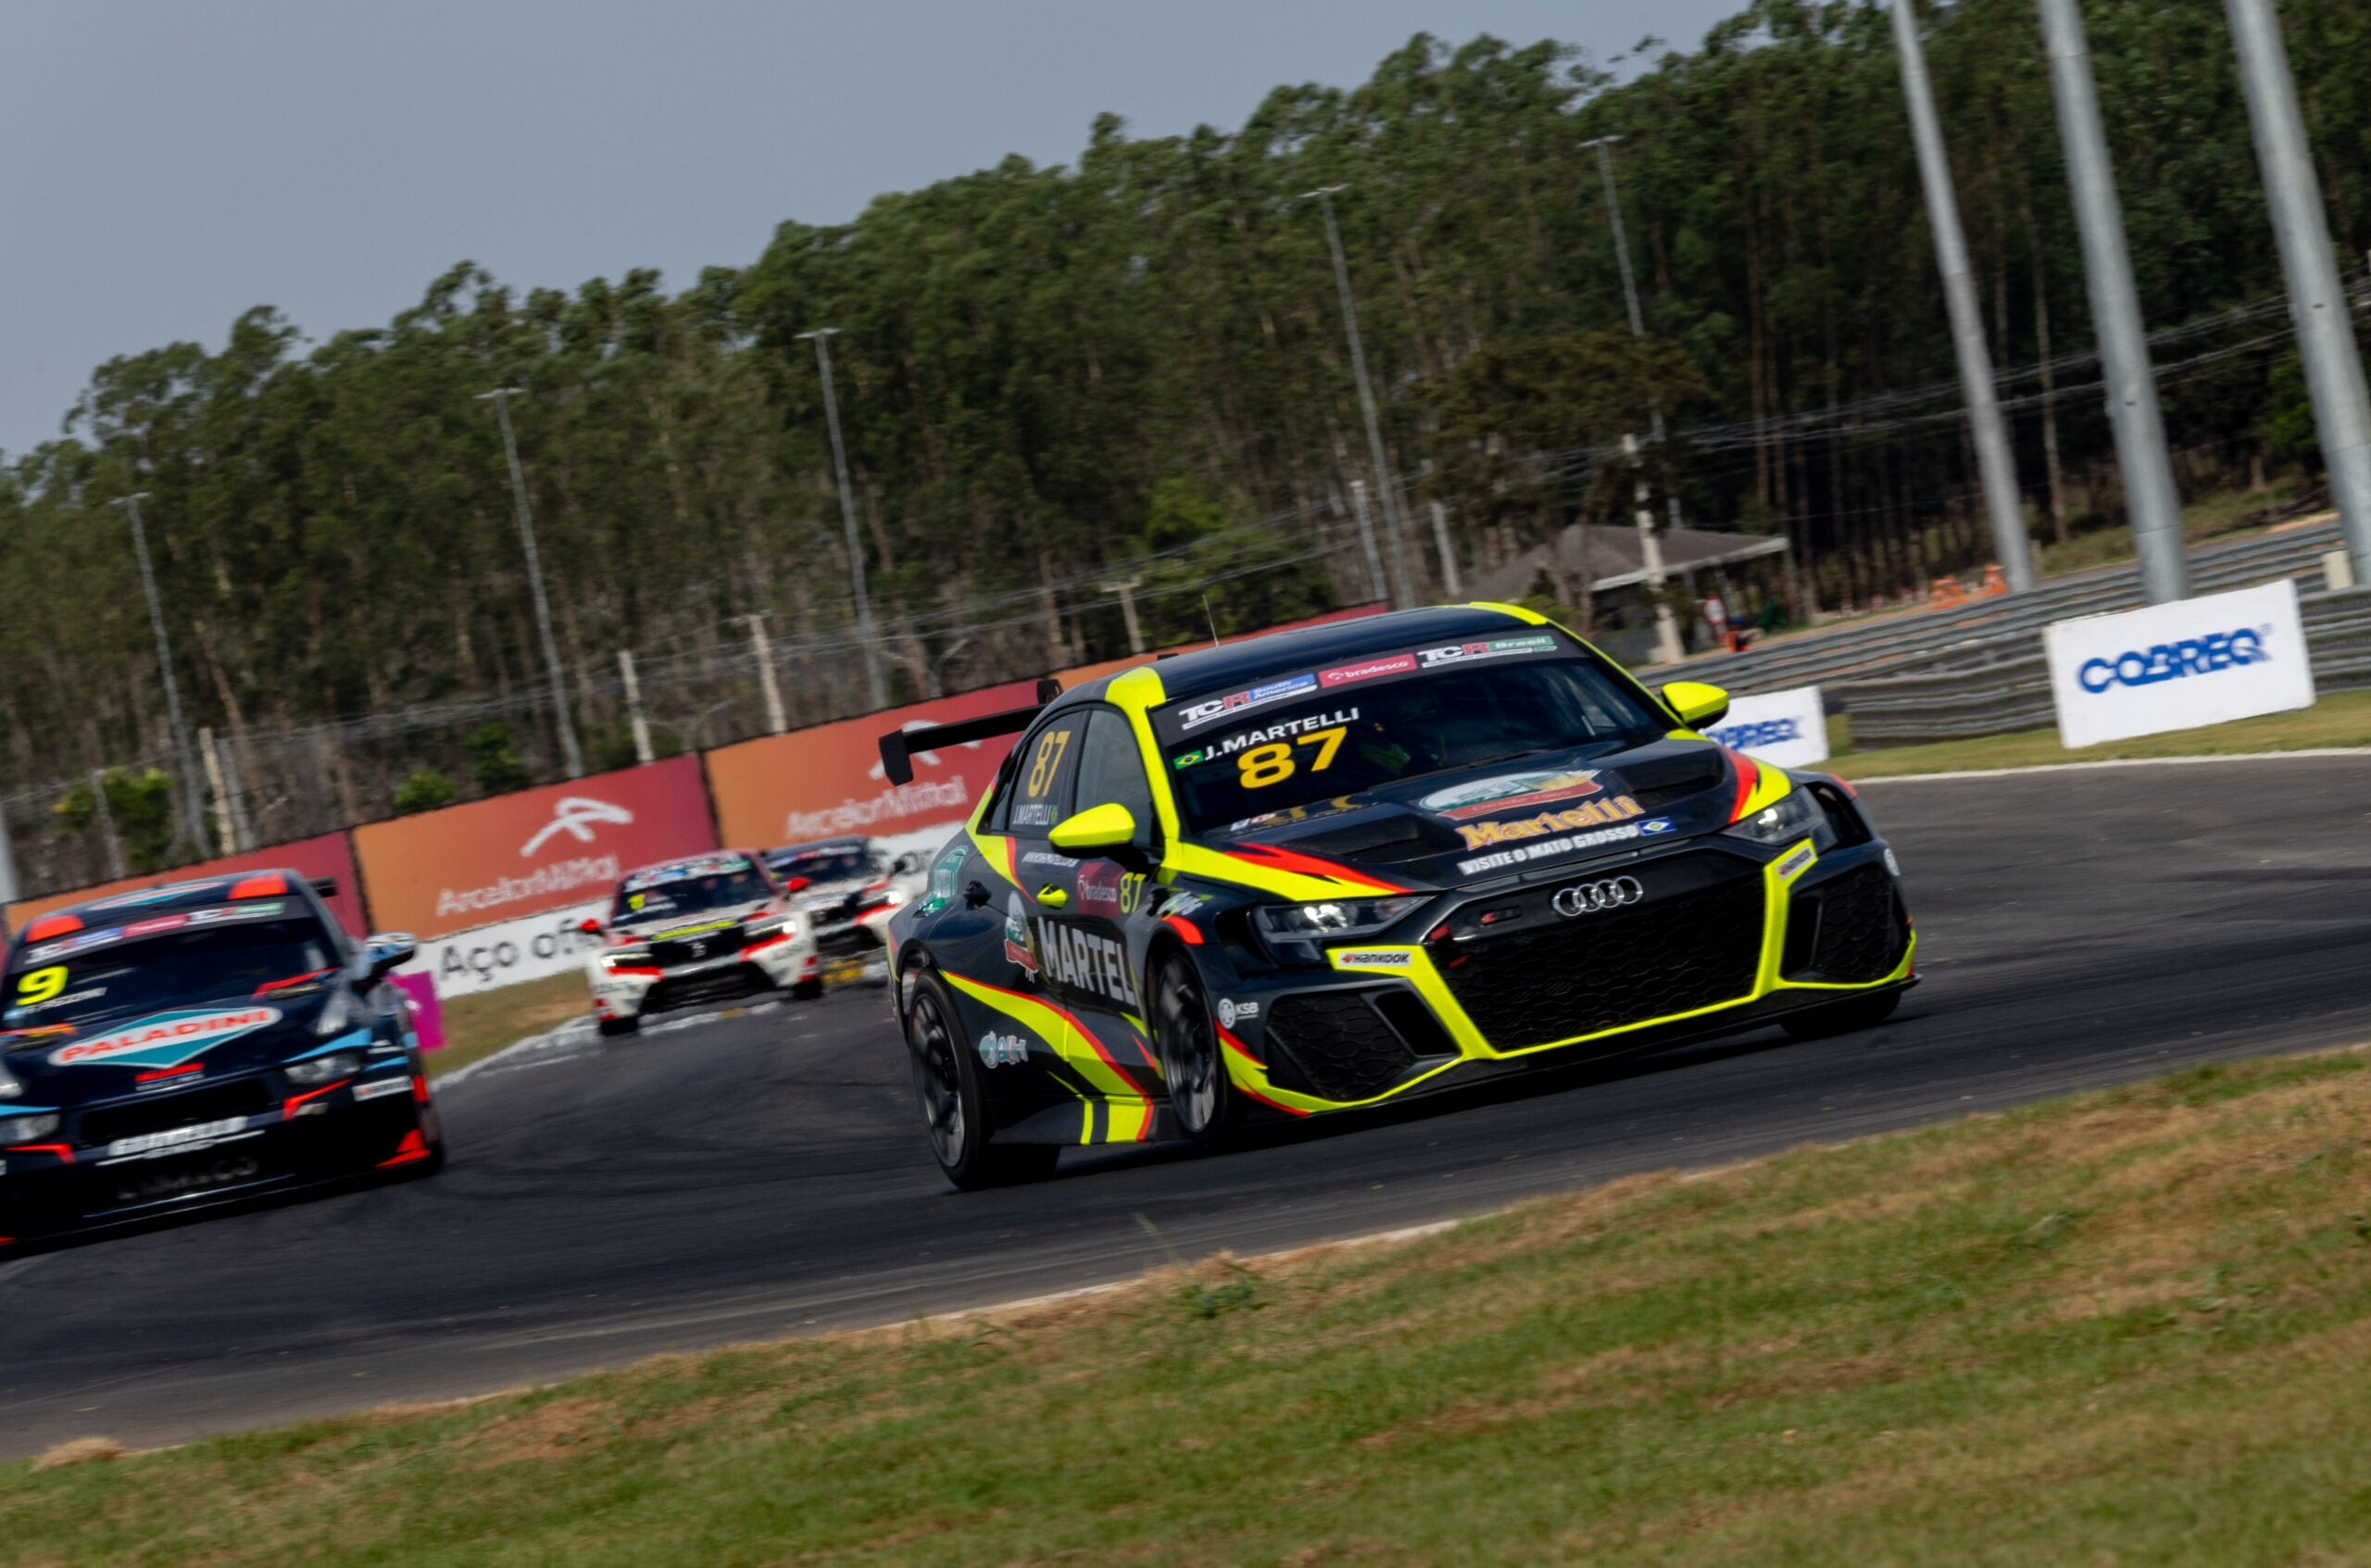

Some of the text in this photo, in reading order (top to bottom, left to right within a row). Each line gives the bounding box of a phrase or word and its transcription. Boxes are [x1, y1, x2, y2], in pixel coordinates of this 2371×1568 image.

[1344, 660, 1410, 678] bradesco
[1417, 642, 1491, 662] TCR
[2077, 627, 2272, 694] COBREQ
[1179, 691, 1251, 721] TCR
[1204, 707, 1361, 760] J.MARTELLI
[1236, 725, 1348, 790] 87
[1027, 730, 1071, 797] 87
[1455, 795, 1646, 851] Martelli
[1457, 823, 1640, 876] VISITE O MATO GROSSO
[1119, 872, 1148, 914] 87
[16, 965, 69, 1007] 9
[440, 940, 519, 983] Aço
[60, 1010, 270, 1062] PALADINI
